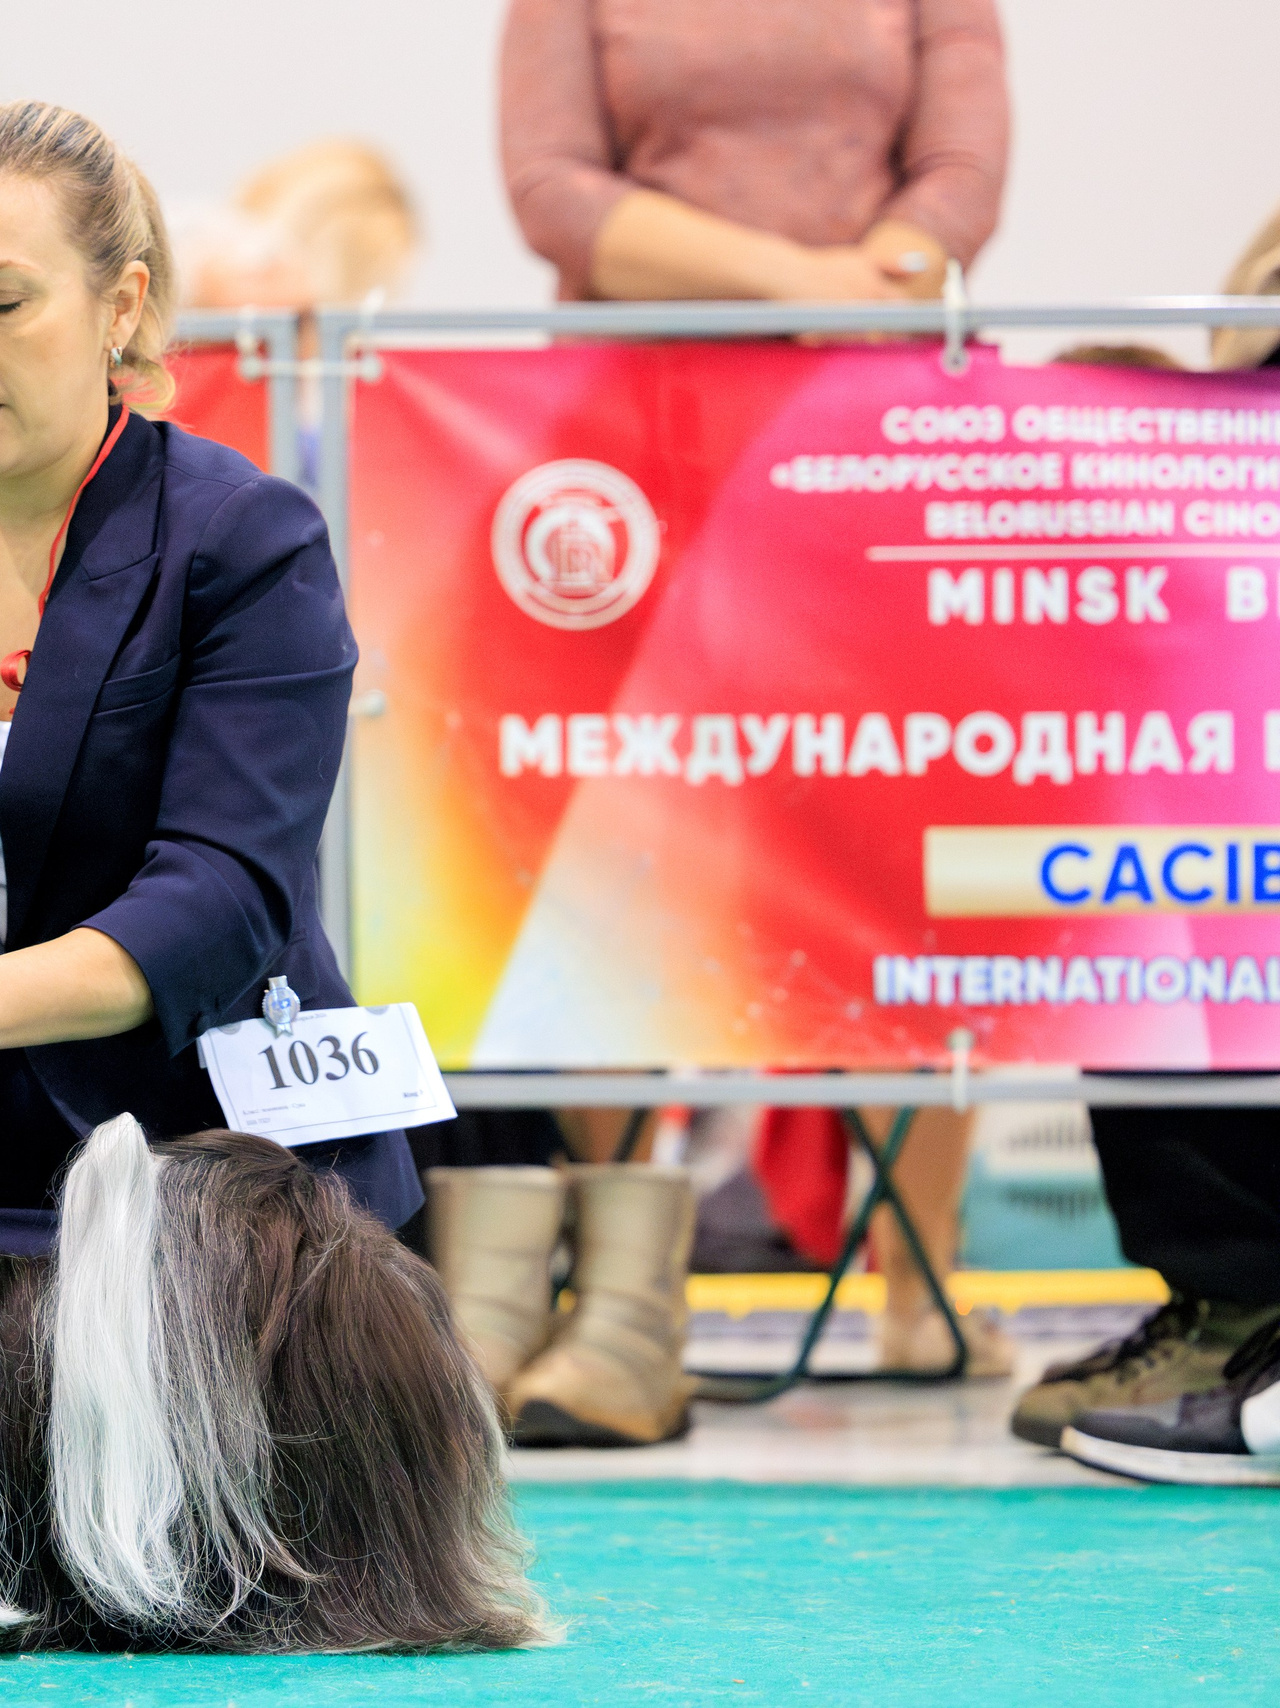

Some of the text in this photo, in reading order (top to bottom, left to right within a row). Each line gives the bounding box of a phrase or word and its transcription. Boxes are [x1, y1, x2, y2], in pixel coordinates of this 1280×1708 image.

[880, 404, 1006, 445] СОЮЗ
[925, 501, 1174, 540] BELORUSSIAN
[927, 566, 1280, 626] MINSK B
[500, 710, 1234, 786] МЕЖДУНАРОДНАЯ
[872, 954, 1280, 1006] INTERNATIONAL
[258, 1030, 380, 1090] 1036
